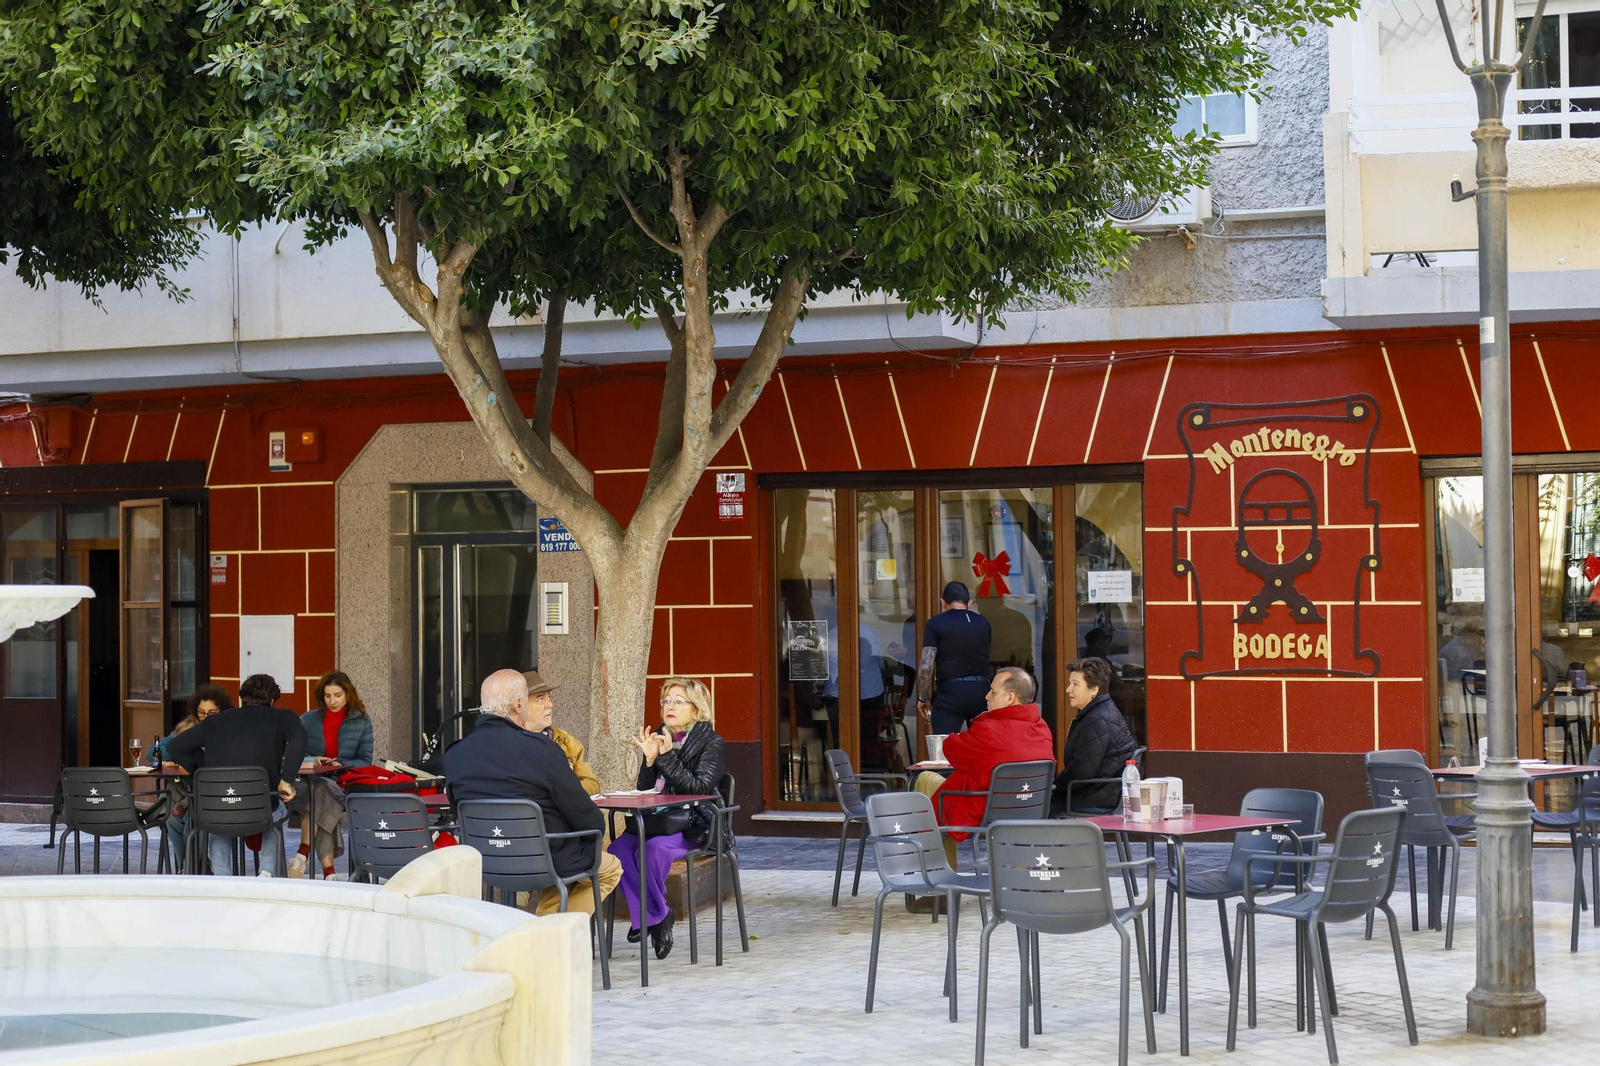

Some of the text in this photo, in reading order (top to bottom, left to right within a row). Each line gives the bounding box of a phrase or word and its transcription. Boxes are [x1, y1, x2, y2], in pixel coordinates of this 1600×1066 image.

[1203, 426, 1357, 475] Montenegro
[540, 543, 553, 552] 619
[555, 542, 568, 551] 177
[1233, 632, 1329, 659] BODEGA
